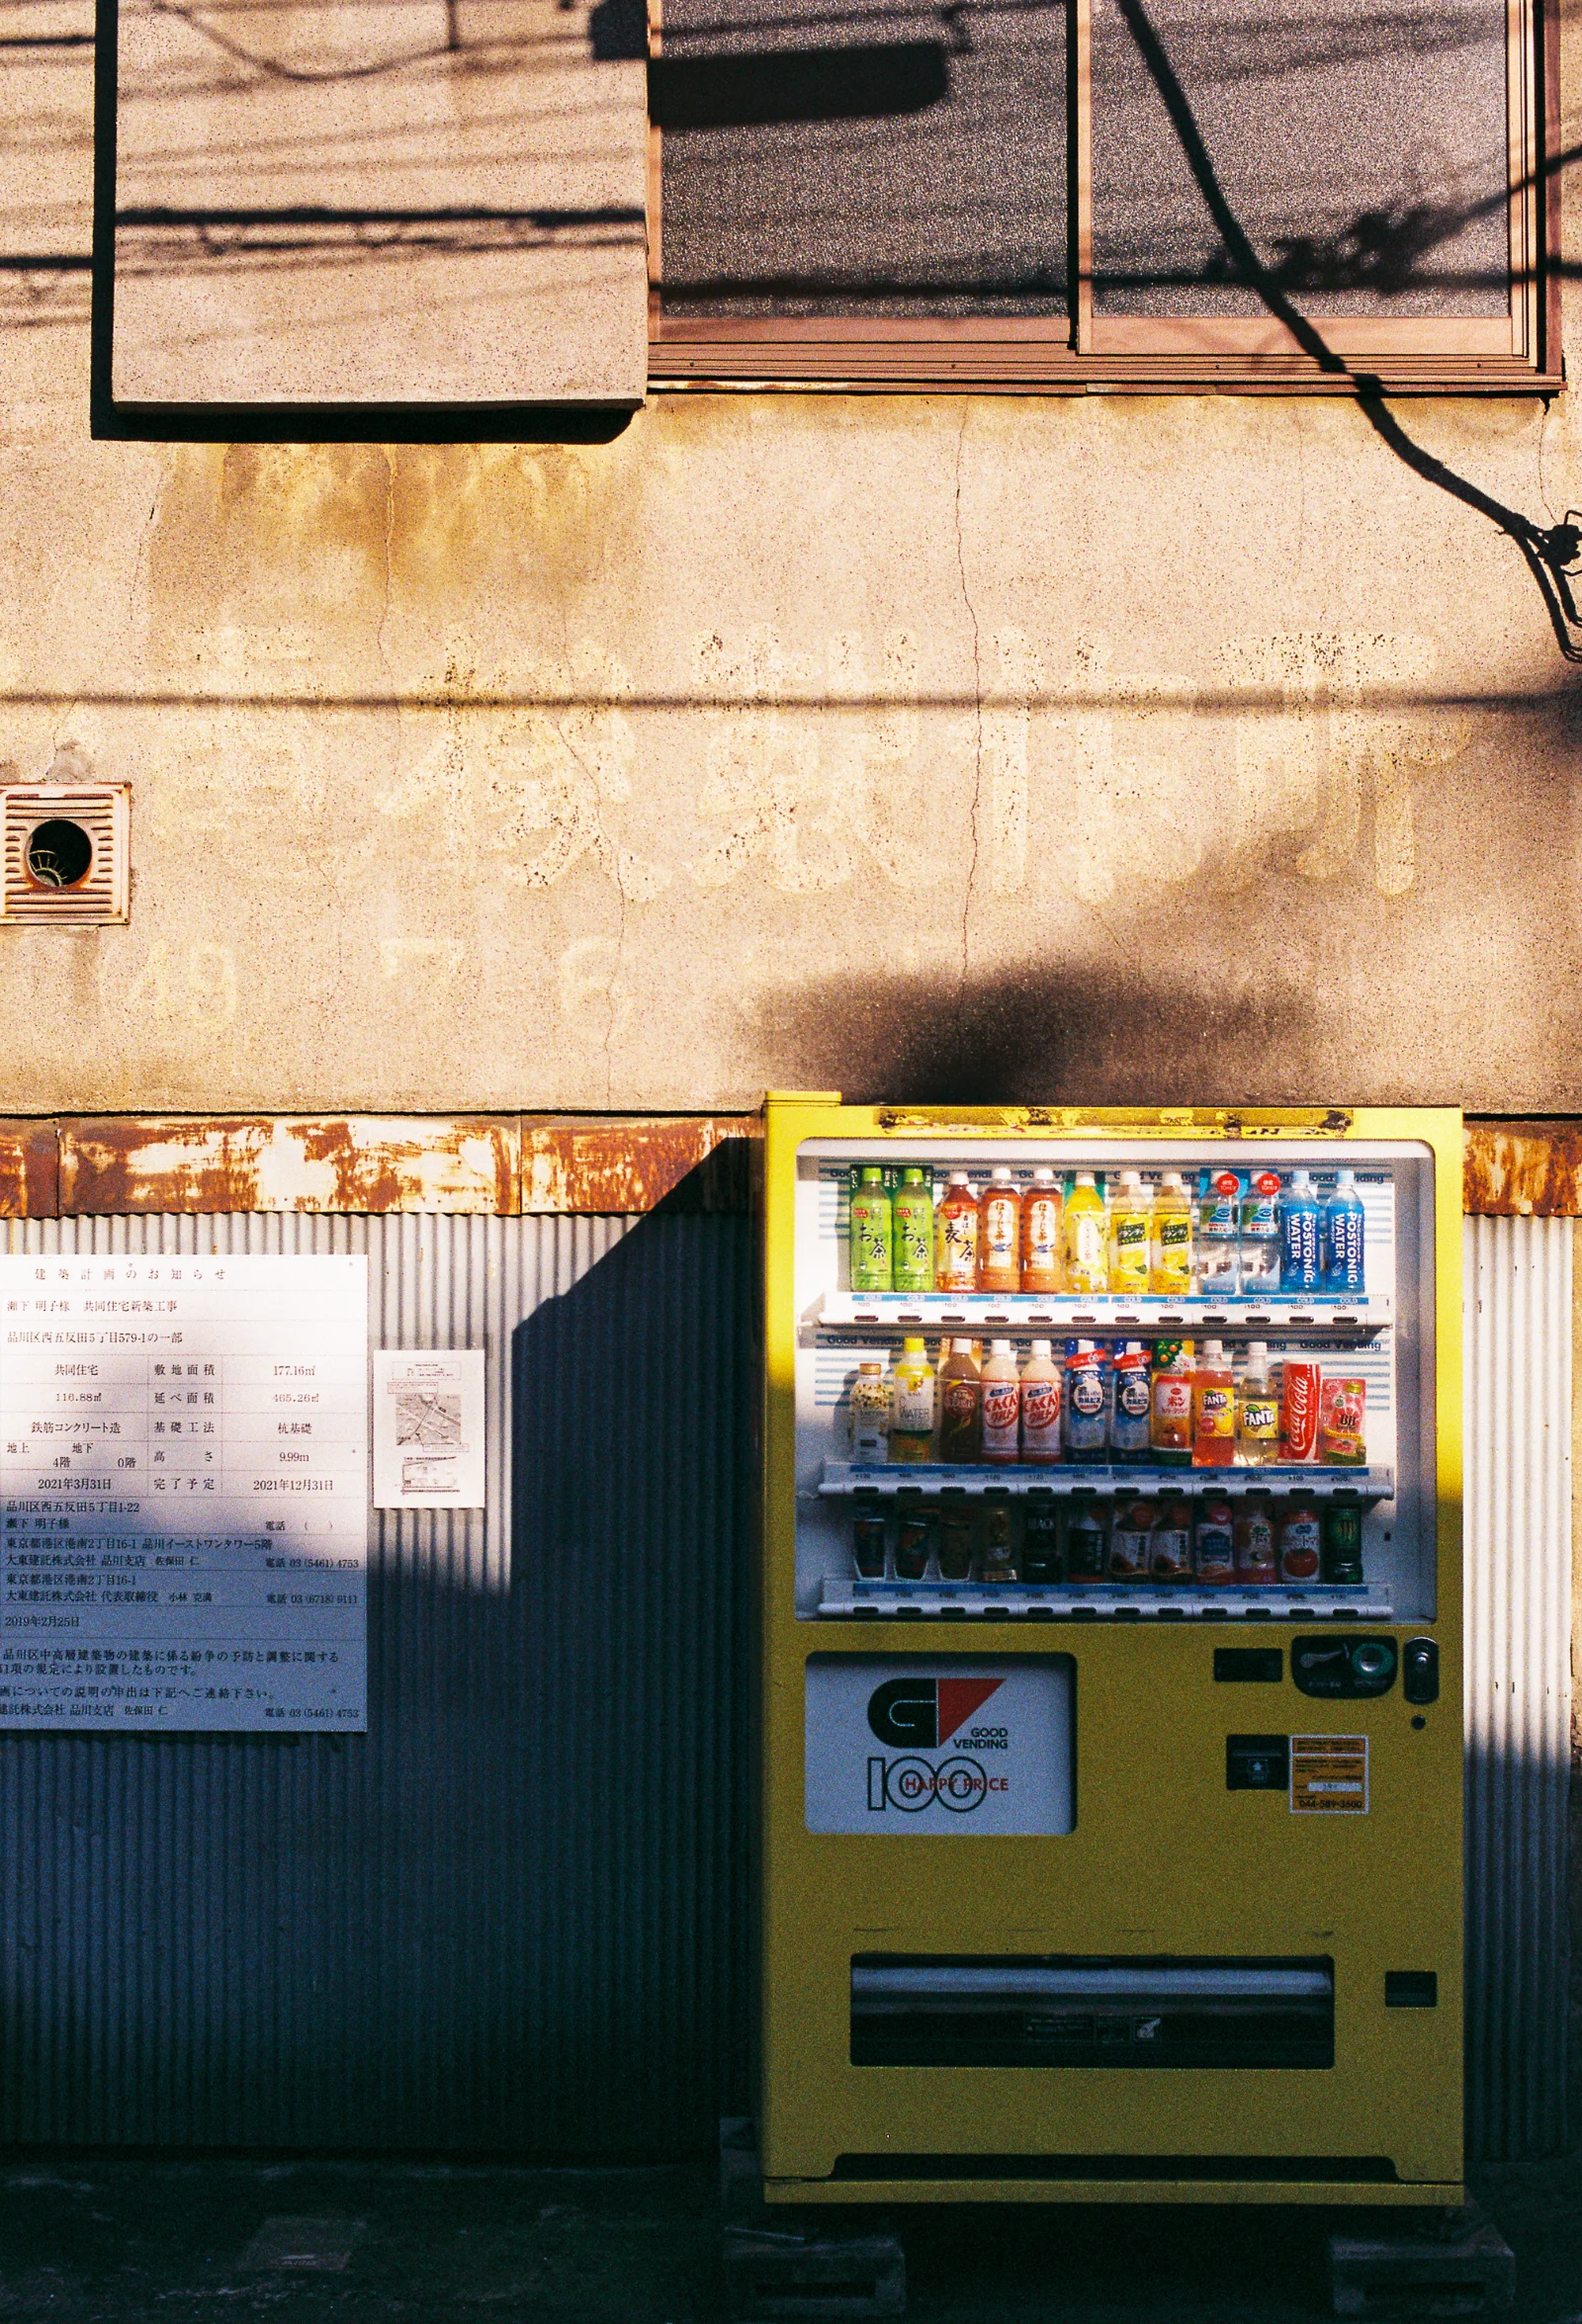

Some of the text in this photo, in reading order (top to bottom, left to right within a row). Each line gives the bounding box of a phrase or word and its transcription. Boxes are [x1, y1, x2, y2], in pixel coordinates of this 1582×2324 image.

[995, 1202, 1006, 1241] ほうじ茶
[1038, 1202, 1048, 1243] ほうじ茶
[858, 1223, 887, 1259] お茶
[901, 1223, 929, 1259] お茶
[945, 1222, 975, 1262] 麦茶
[1290, 1214, 1301, 1258] WATER
[1335, 1214, 1346, 1258] WATER
[36, 1268, 226, 1280] 建築計画のお知らせ
[36, 1301, 70, 1312] 明子様
[83, 1301, 177, 1312] 共同住宅新築工事
[7, 1332, 183, 1343] 品川区西五反田5丁目579-1の一部
[828, 1334, 904, 1344] Good Vendin
[1299, 1339, 1382, 1351] Good Vending
[54, 1364, 99, 1376] 共同住宅
[154, 1364, 216, 1375] 敷地面積
[154, 1392, 215, 1404] 延べ面積
[1202, 1392, 1227, 1406] FANTA
[900, 1409, 929, 1420] WATER
[1243, 1410, 1275, 1426] FANTA
[32, 1421, 121, 1434] 鉄筋コンクリート造
[154, 1421, 215, 1433] 基礎工法
[278, 1422, 312, 1434] 杭基礎
[7, 1442, 94, 1453] 地上 地下
[53, 1456, 136, 1468] 4階 0階
[279, 1452, 309, 1462] 9.99m
[38, 1479, 111, 1490] 2021年3月31日
[154, 1478, 215, 1490] 完了予定
[253, 1479, 333, 1491] 2021年12月31日
[6, 1502, 139, 1512] 品川区西五反田5丁目1-22
[36, 1518, 69, 1529] 明子様
[265, 1520, 285, 1531] 電話
[6, 1538, 272, 1550] 東京都港区港南2丁目16-1 品川イーストワンタワー5階
[6, 1555, 96, 1566] 大東建託株式会社
[102, 1556, 145, 1567] 品川支店
[265, 1558, 286, 1569] 電話
[6, 1574, 136, 1585] 東京都港区港南2丁目16-1
[6, 1591, 97, 1601] 大東建託株式会社
[102, 1591, 158, 1602] 代表取締役
[267, 1593, 287, 1604] 電話
[5, 1616, 79, 1627] 2019年2月25日
[69, 1704, 115, 1716] 品川支店
[265, 1708, 285, 1718] 電話
[971, 1727, 1009, 1738] GOOD
[953, 1739, 1009, 1750] VENDING
[905, 1777, 1010, 1791] HAPPY PRICE
